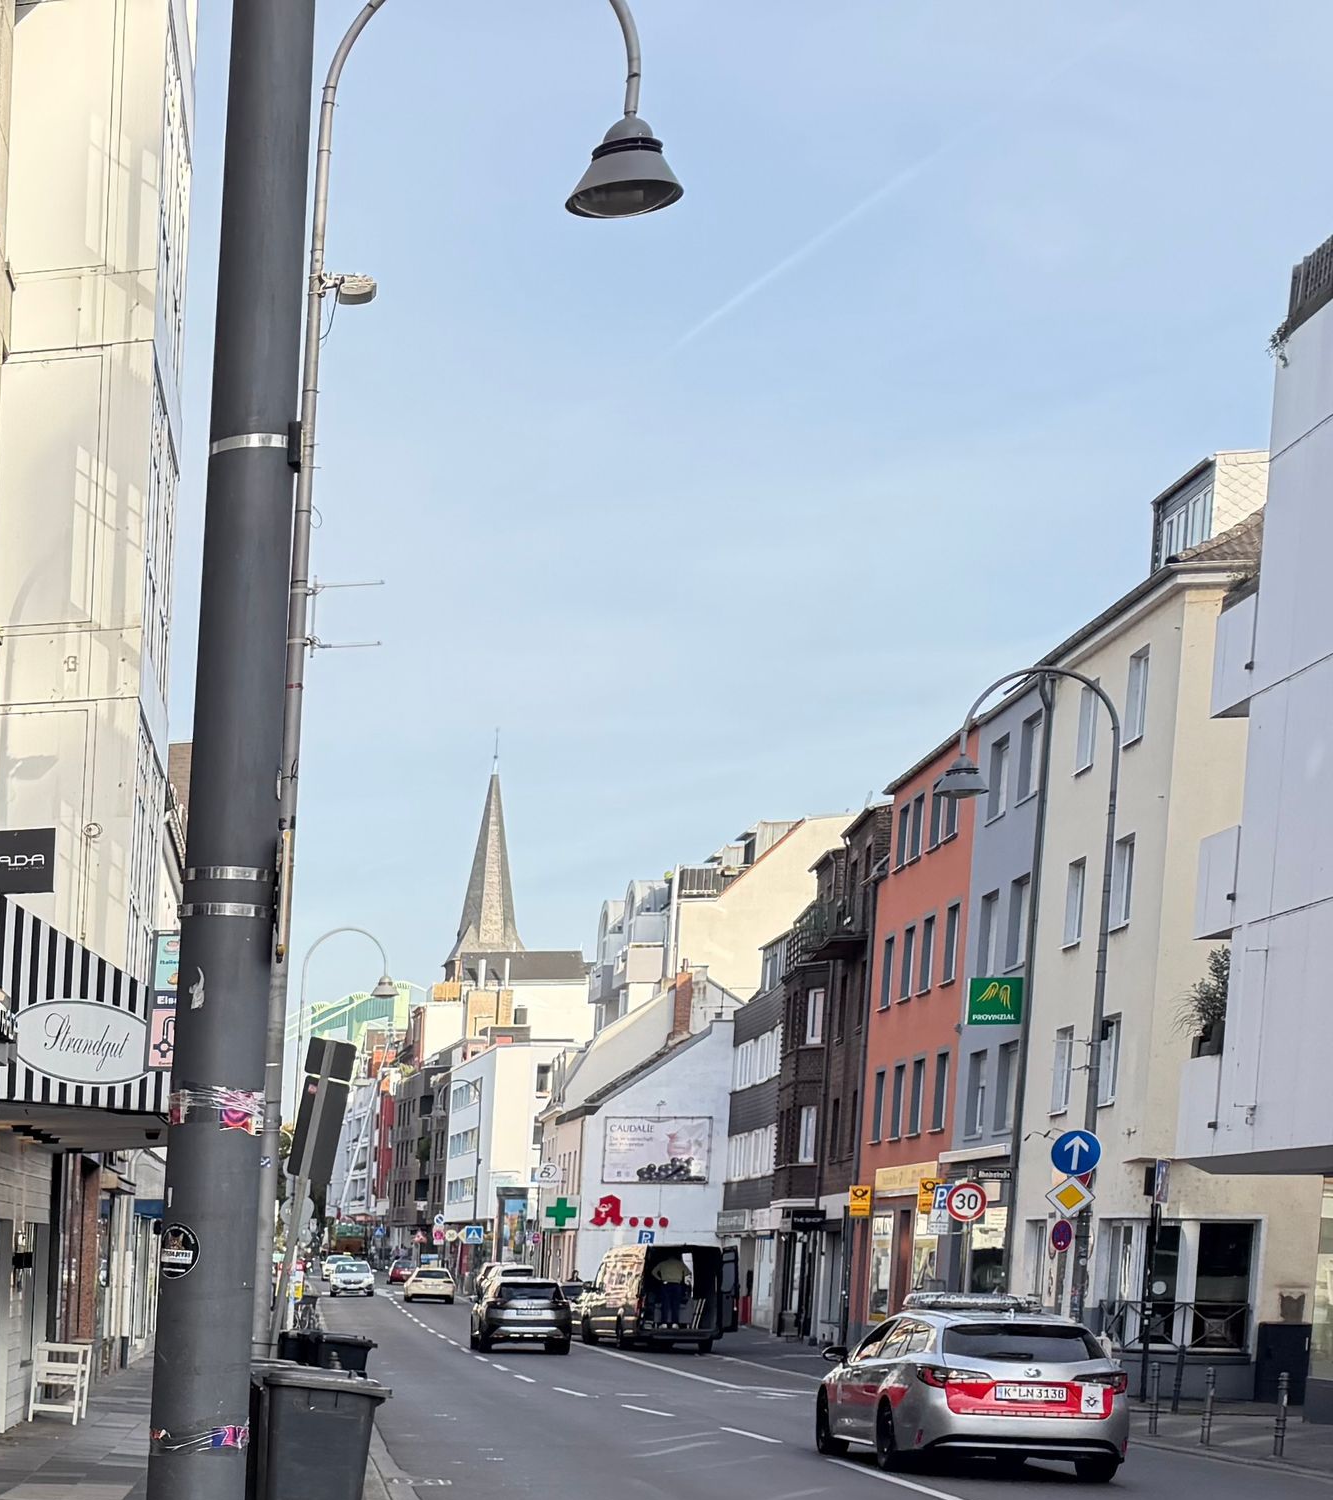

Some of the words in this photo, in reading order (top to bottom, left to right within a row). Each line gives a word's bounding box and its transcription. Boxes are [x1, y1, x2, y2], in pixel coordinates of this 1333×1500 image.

[972, 1013, 1015, 1021] PROVINZIAL
[44, 1013, 130, 1071] Strandgut
[955, 1193, 978, 1210] 30
[1004, 1388, 1011, 1397] K
